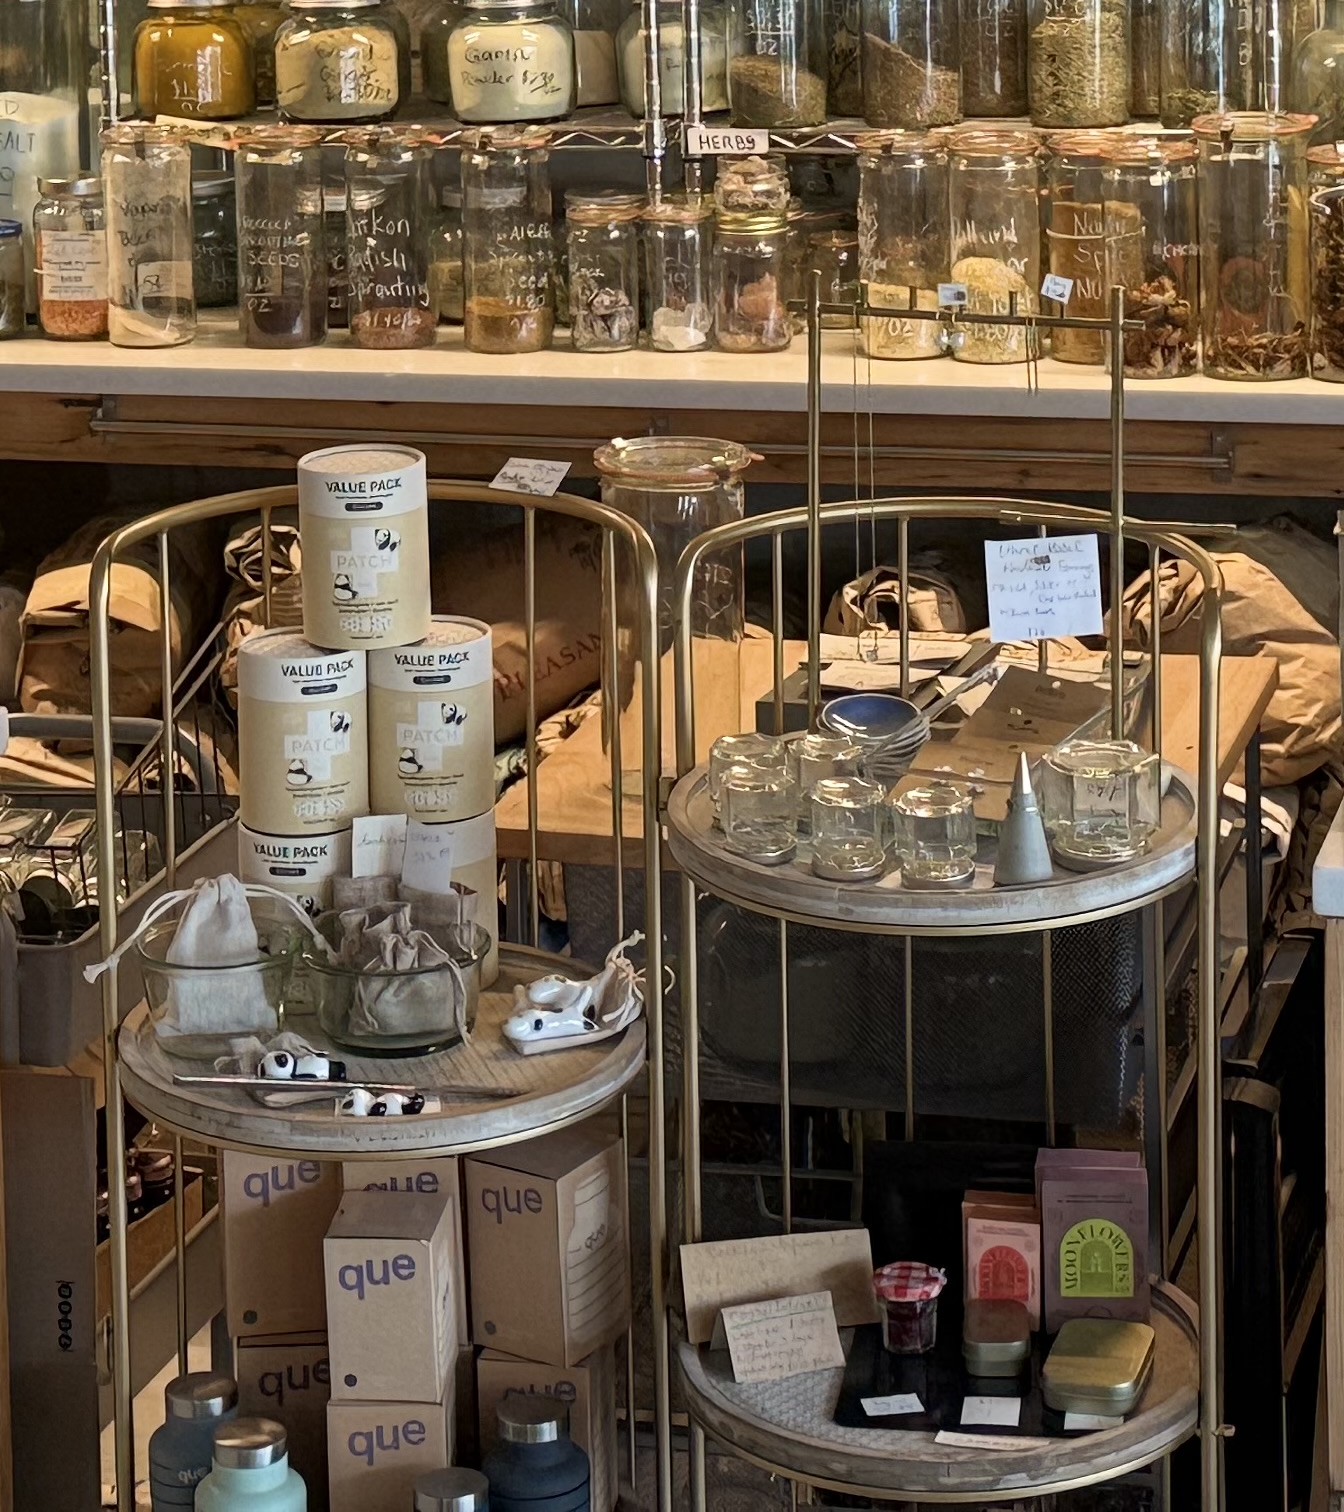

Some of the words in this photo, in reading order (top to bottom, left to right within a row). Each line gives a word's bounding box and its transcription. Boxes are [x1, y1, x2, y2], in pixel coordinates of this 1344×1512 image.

[697, 132, 759, 152] HERBS
[325, 480, 367, 495] VALUE
[369, 477, 403, 493] PACK
[336, 554, 393, 569] PATCH
[394, 652, 435, 667] VALUE
[438, 650, 471, 666] PACK
[253, 842, 290, 859] VALUE
[292, 843, 329, 859] PACK
[243, 1159, 322, 1206] que
[482, 1184, 543, 1224] que
[338, 1254, 417, 1300] que
[258, 1356, 331, 1406] que
[347, 1418, 427, 1467] que
